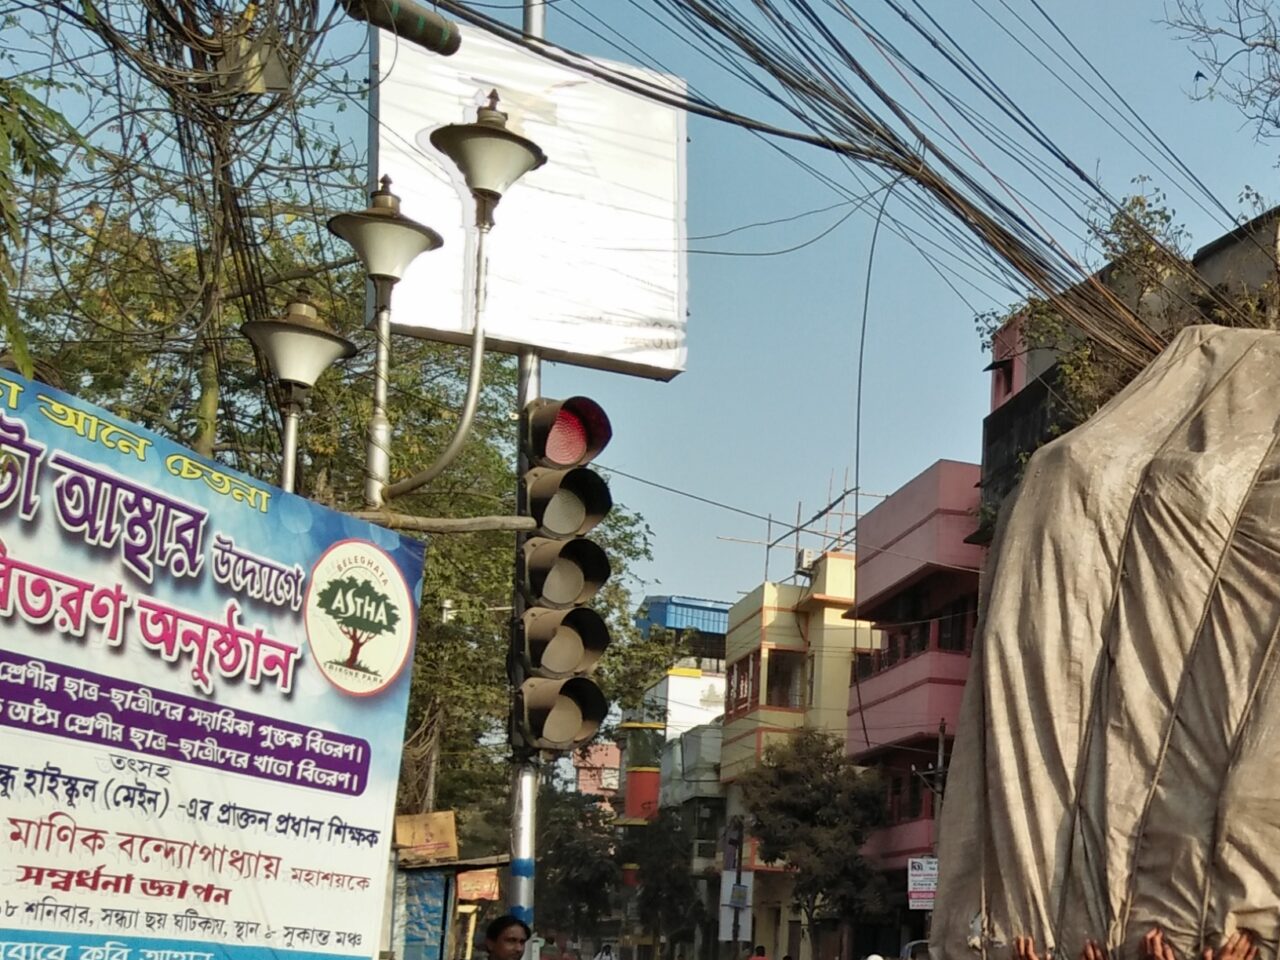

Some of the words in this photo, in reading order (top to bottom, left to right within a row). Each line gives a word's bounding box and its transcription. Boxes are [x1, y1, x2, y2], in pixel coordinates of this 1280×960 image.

[37, 394, 152, 461] আনে
[166, 454, 272, 513] চেতনা
[50, 450, 208, 582] আস্থার
[211, 533, 304, 609] উদ্যোগে
[336, 555, 389, 587] BELEGHATA
[331, 588, 388, 625] ASTHA
[136, 600, 299, 694] অনুষ্ঠান
[65, 712, 125, 742] শ্রেণীর
[253, 755, 293, 779] খাতা
[109, 753, 172, 783] তৎসহ
[258, 724, 302, 749] পুস্তক
[24, 761, 99, 808] হাইস্কুল
[275, 812, 325, 840] প্রধান
[327, 815, 381, 848] শিক্ষক
